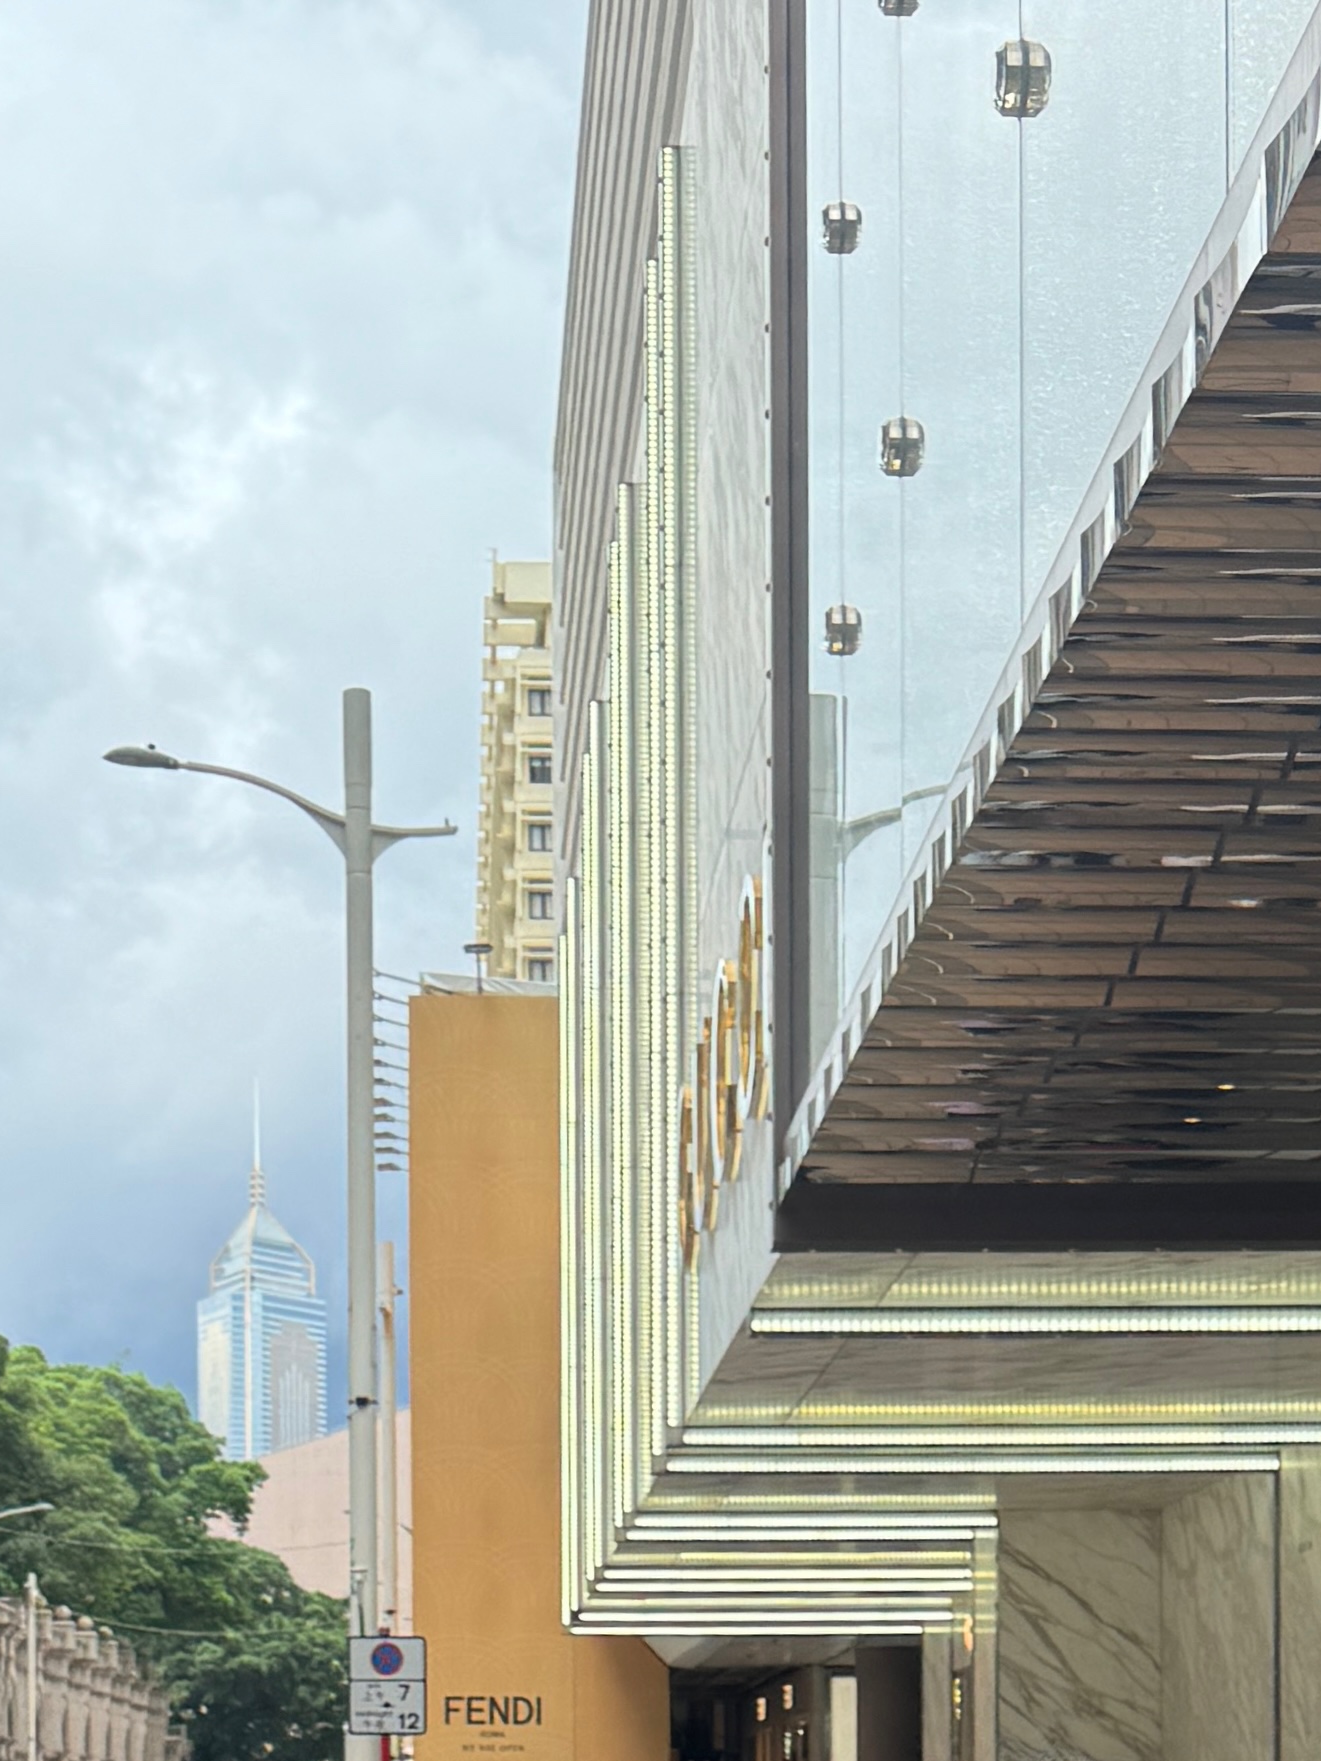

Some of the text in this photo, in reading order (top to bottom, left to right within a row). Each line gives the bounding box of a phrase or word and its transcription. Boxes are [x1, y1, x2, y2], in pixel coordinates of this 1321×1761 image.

[398, 1684, 410, 1701] 7
[445, 1696, 541, 1725] FENDI
[398, 1713, 420, 1730] 12
